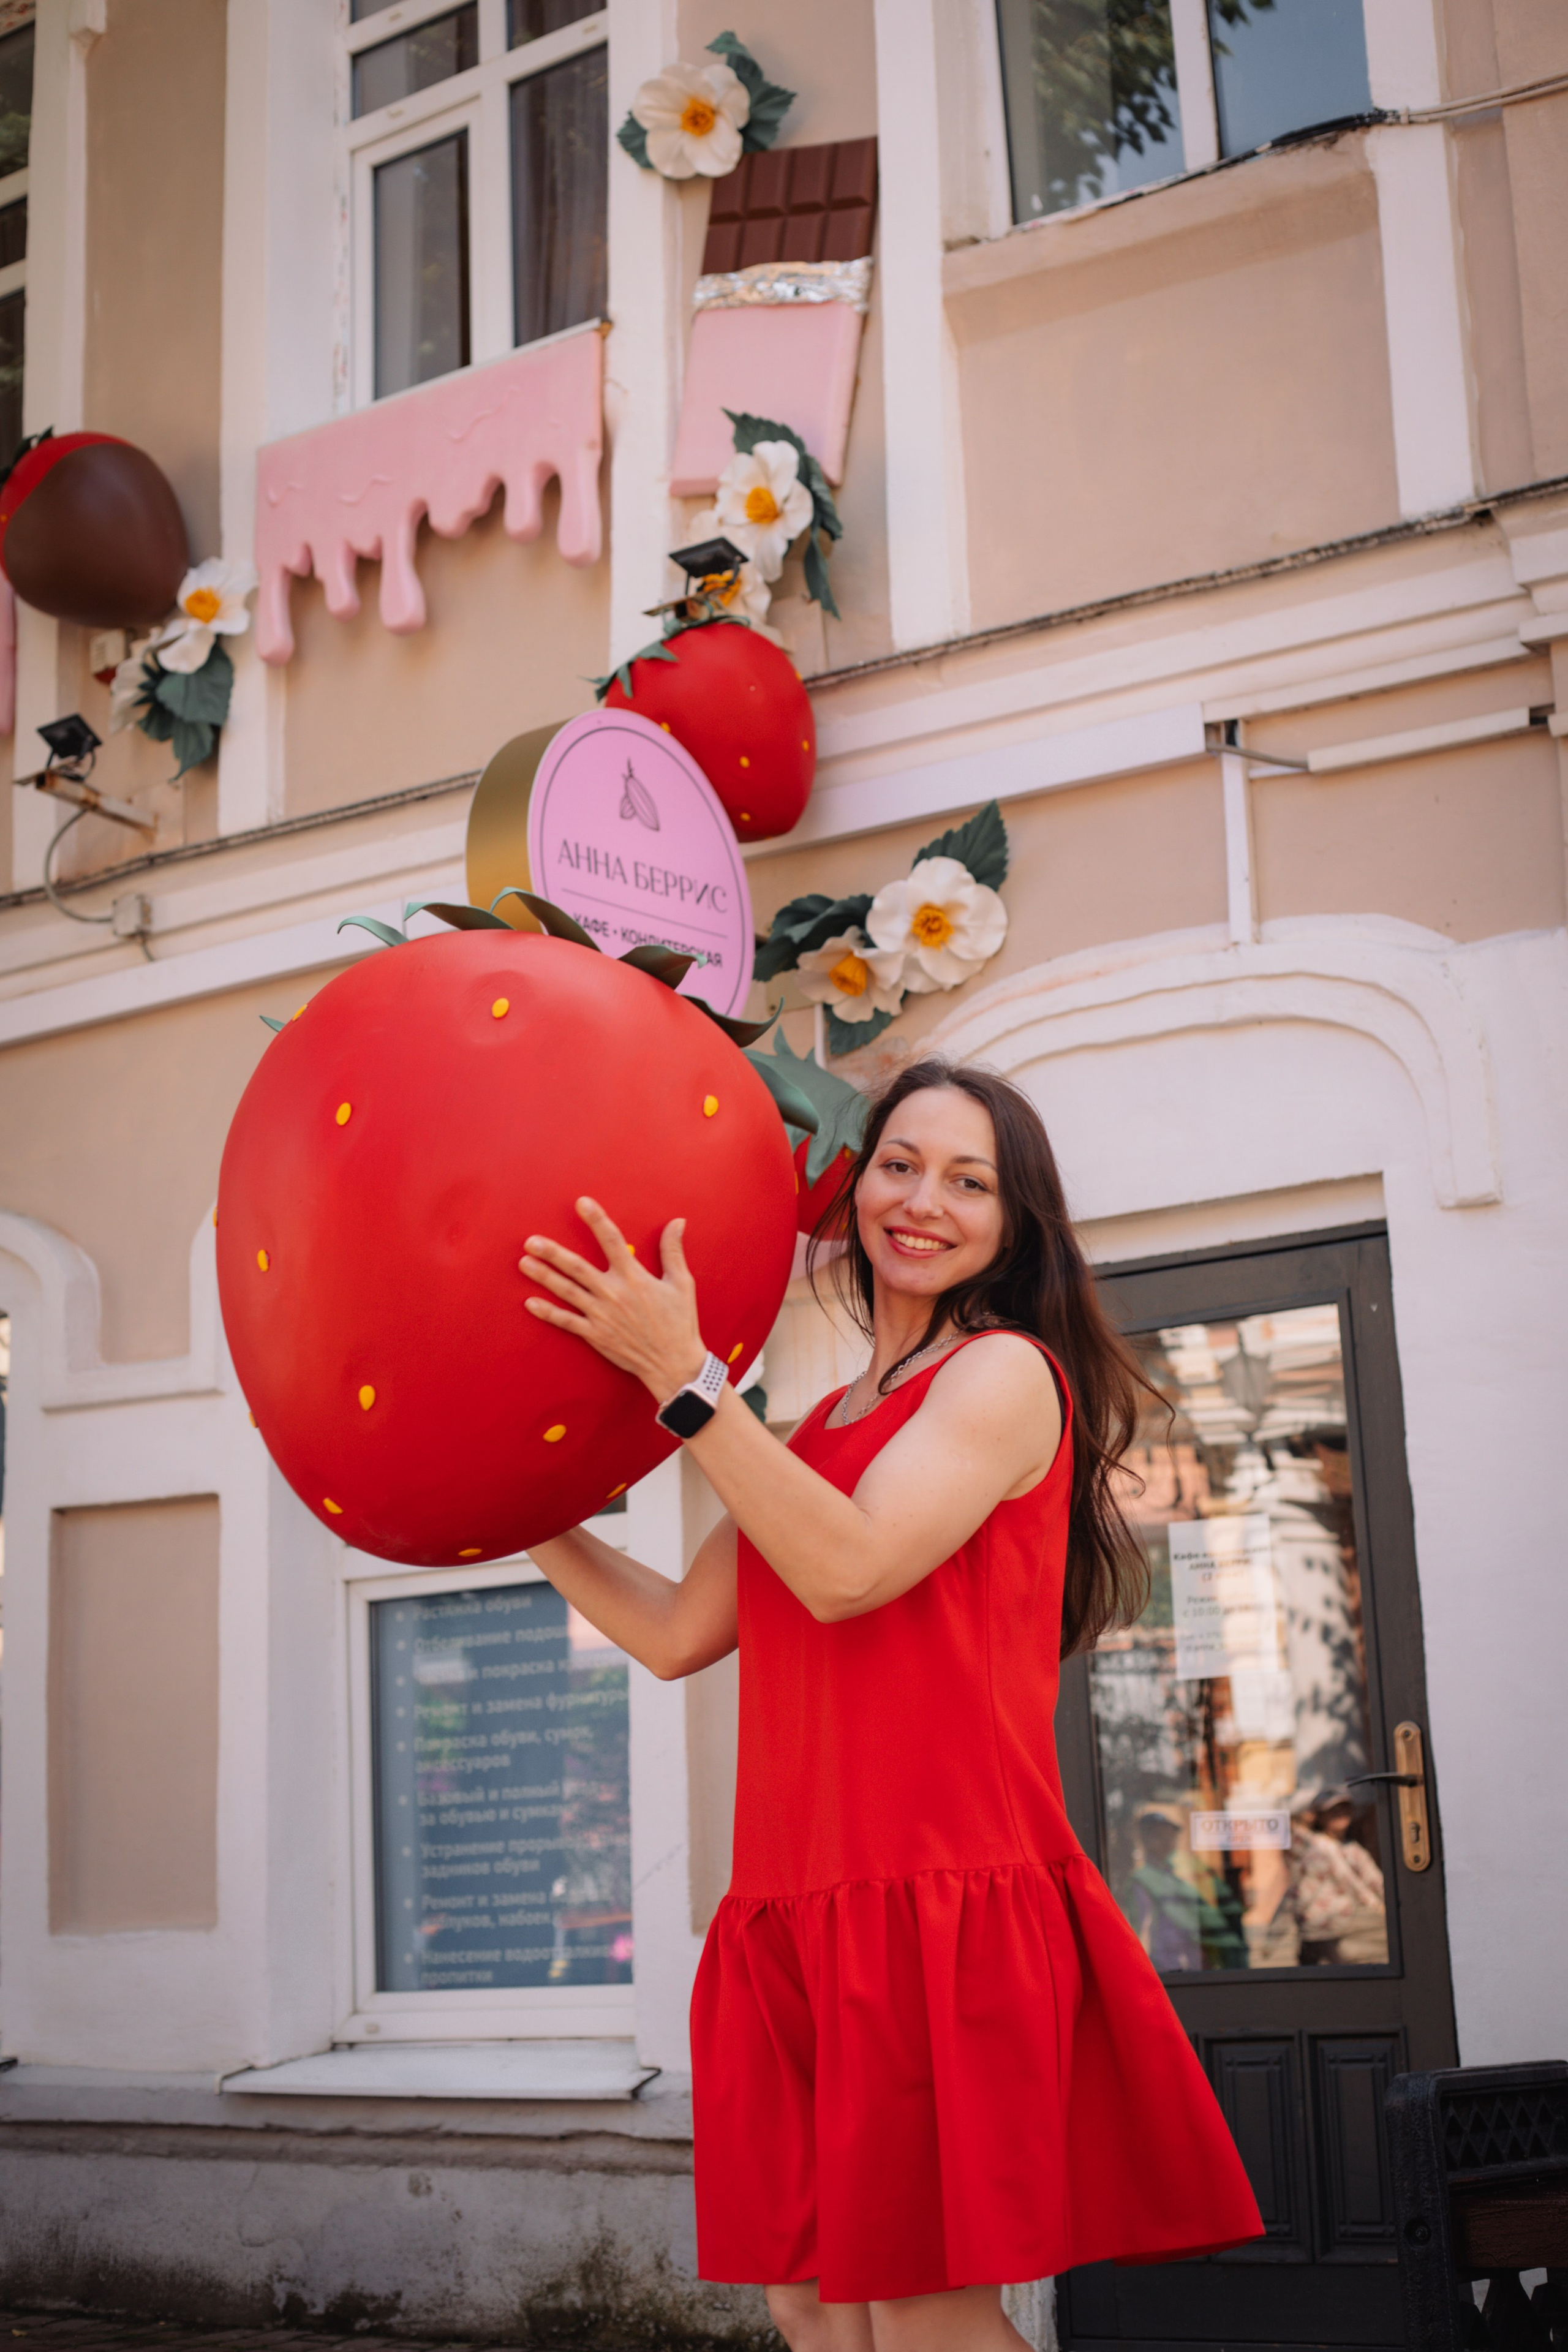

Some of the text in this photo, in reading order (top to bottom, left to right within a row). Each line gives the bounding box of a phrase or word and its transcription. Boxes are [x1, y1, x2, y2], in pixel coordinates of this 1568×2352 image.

[558, 839, 728, 914] АННА БЕРРИС
[484, 1596, 532, 1615] обуви
[482, 1660, 554, 1680] покраска
[487, 1696, 543, 1713] замена
[1201, 1818, 1279, 1833] ОТКРЫТО
[492, 1856, 540, 1877] обуви
